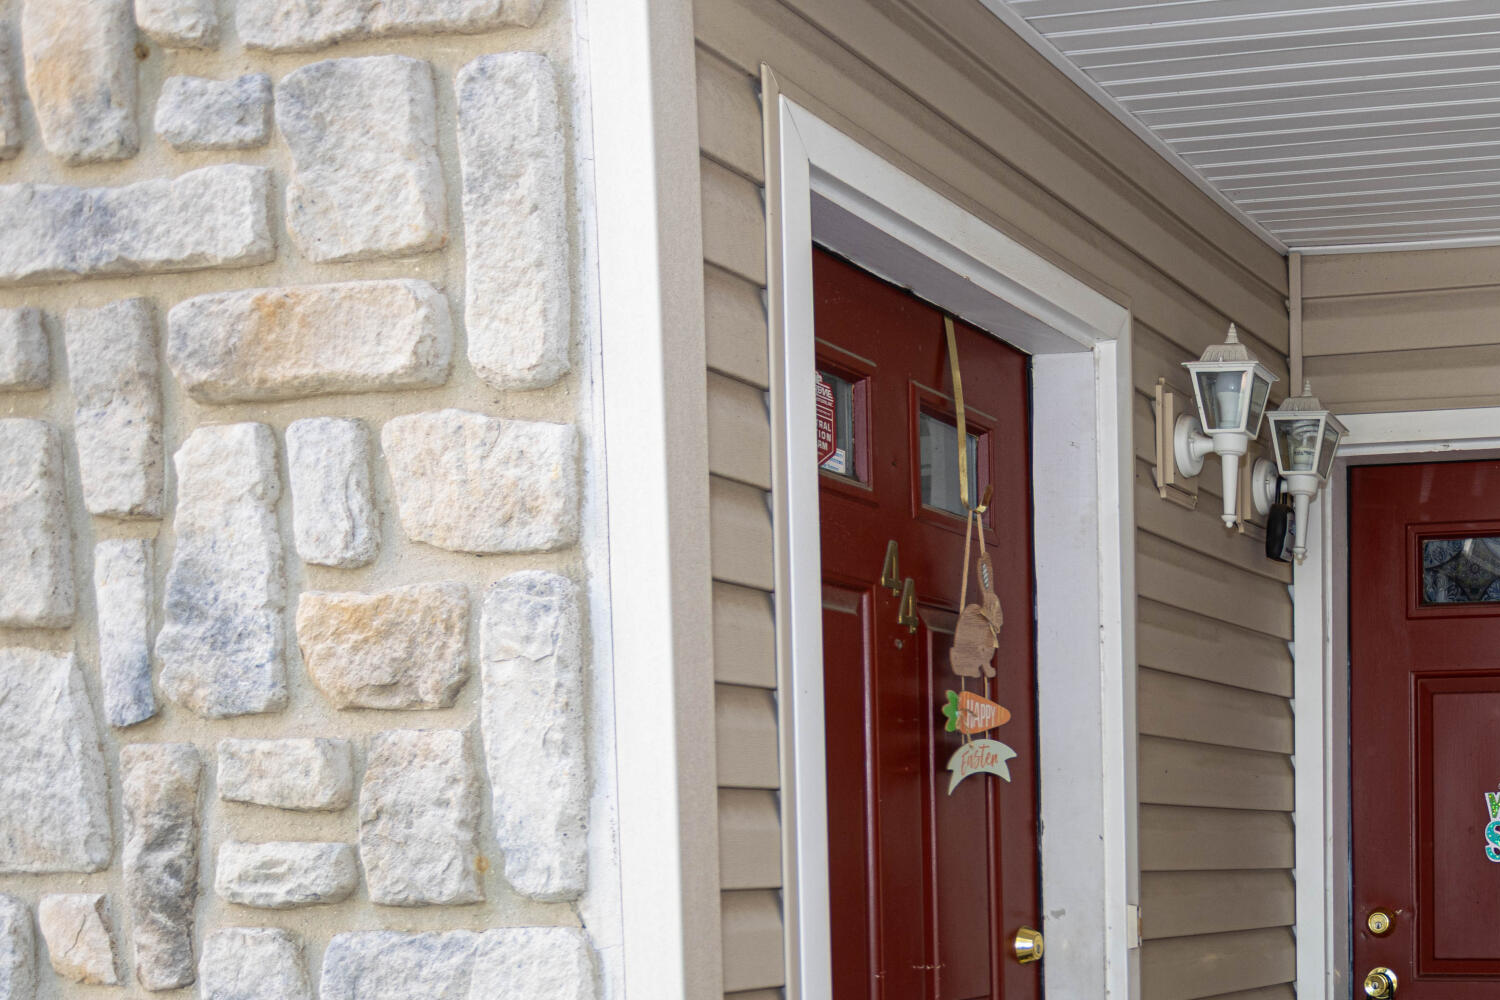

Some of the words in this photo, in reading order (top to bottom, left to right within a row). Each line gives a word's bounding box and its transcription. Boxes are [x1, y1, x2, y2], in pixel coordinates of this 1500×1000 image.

[881, 539, 919, 634] 44
[966, 697, 996, 730] HAPPY
[960, 743, 999, 777] Easter
